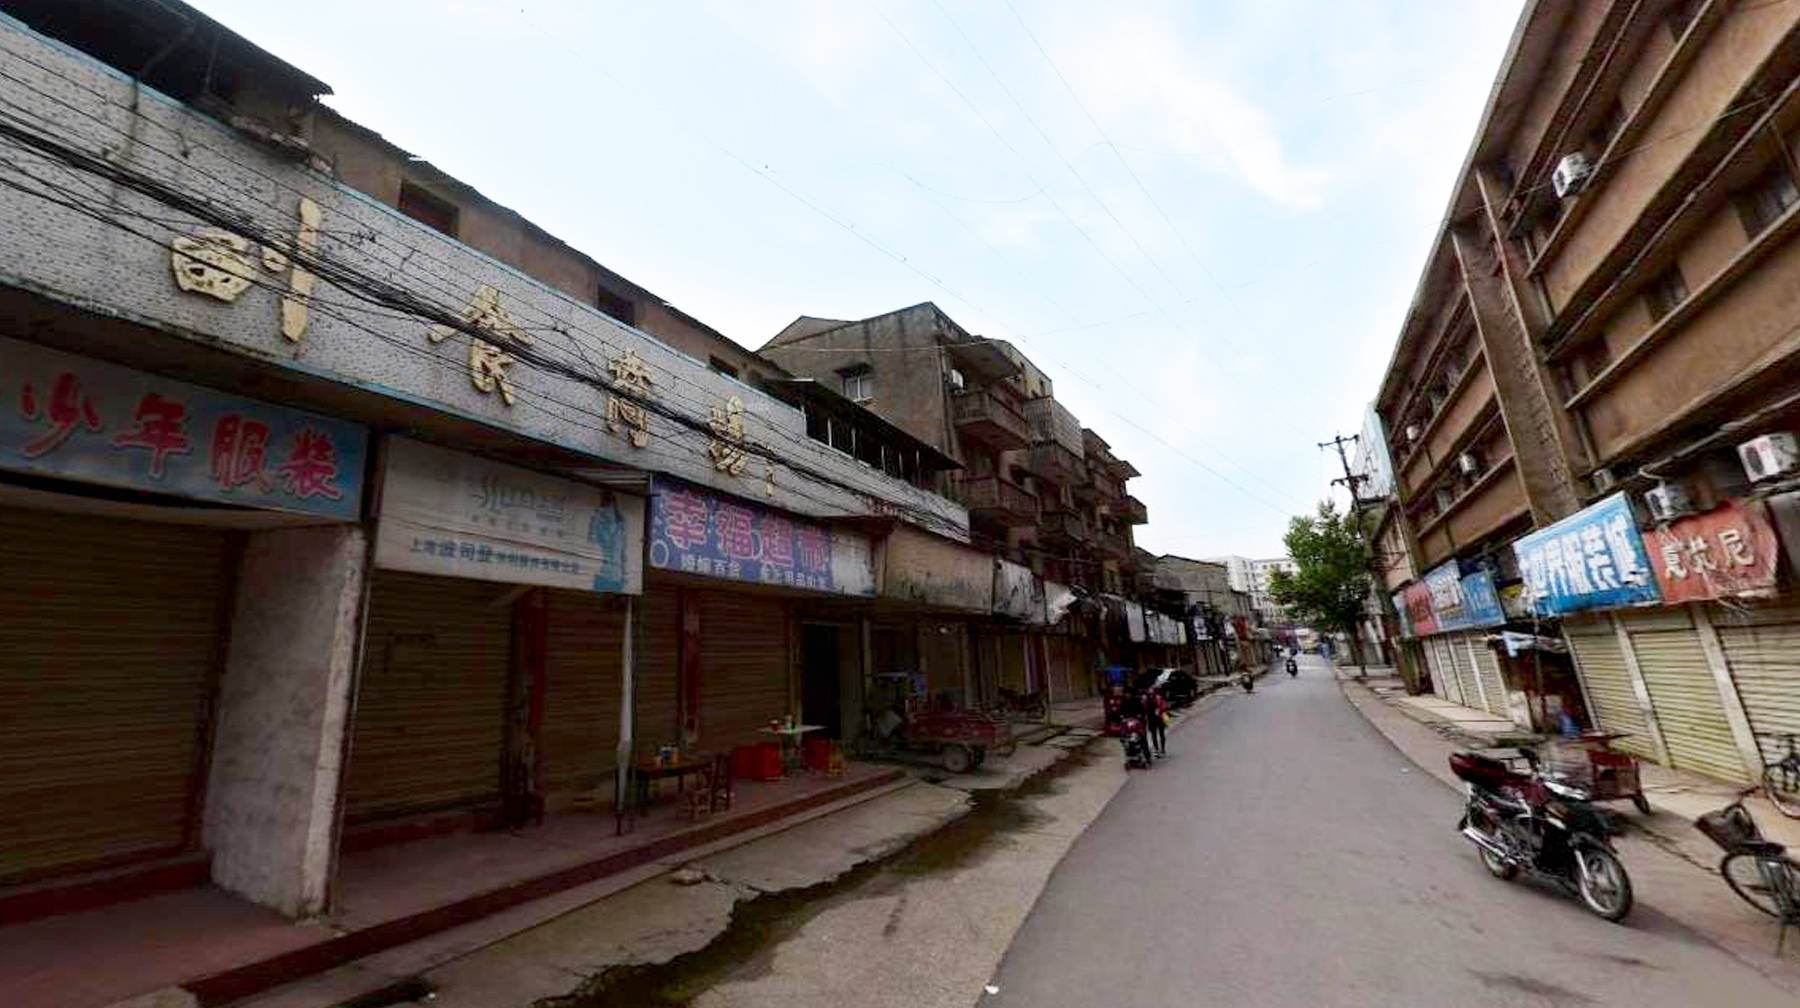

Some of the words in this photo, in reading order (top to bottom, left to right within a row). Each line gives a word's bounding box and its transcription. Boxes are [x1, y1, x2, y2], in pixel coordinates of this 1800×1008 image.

[18, 371, 345, 501] 少年服装
[663, 490, 828, 573] 幸福超市
